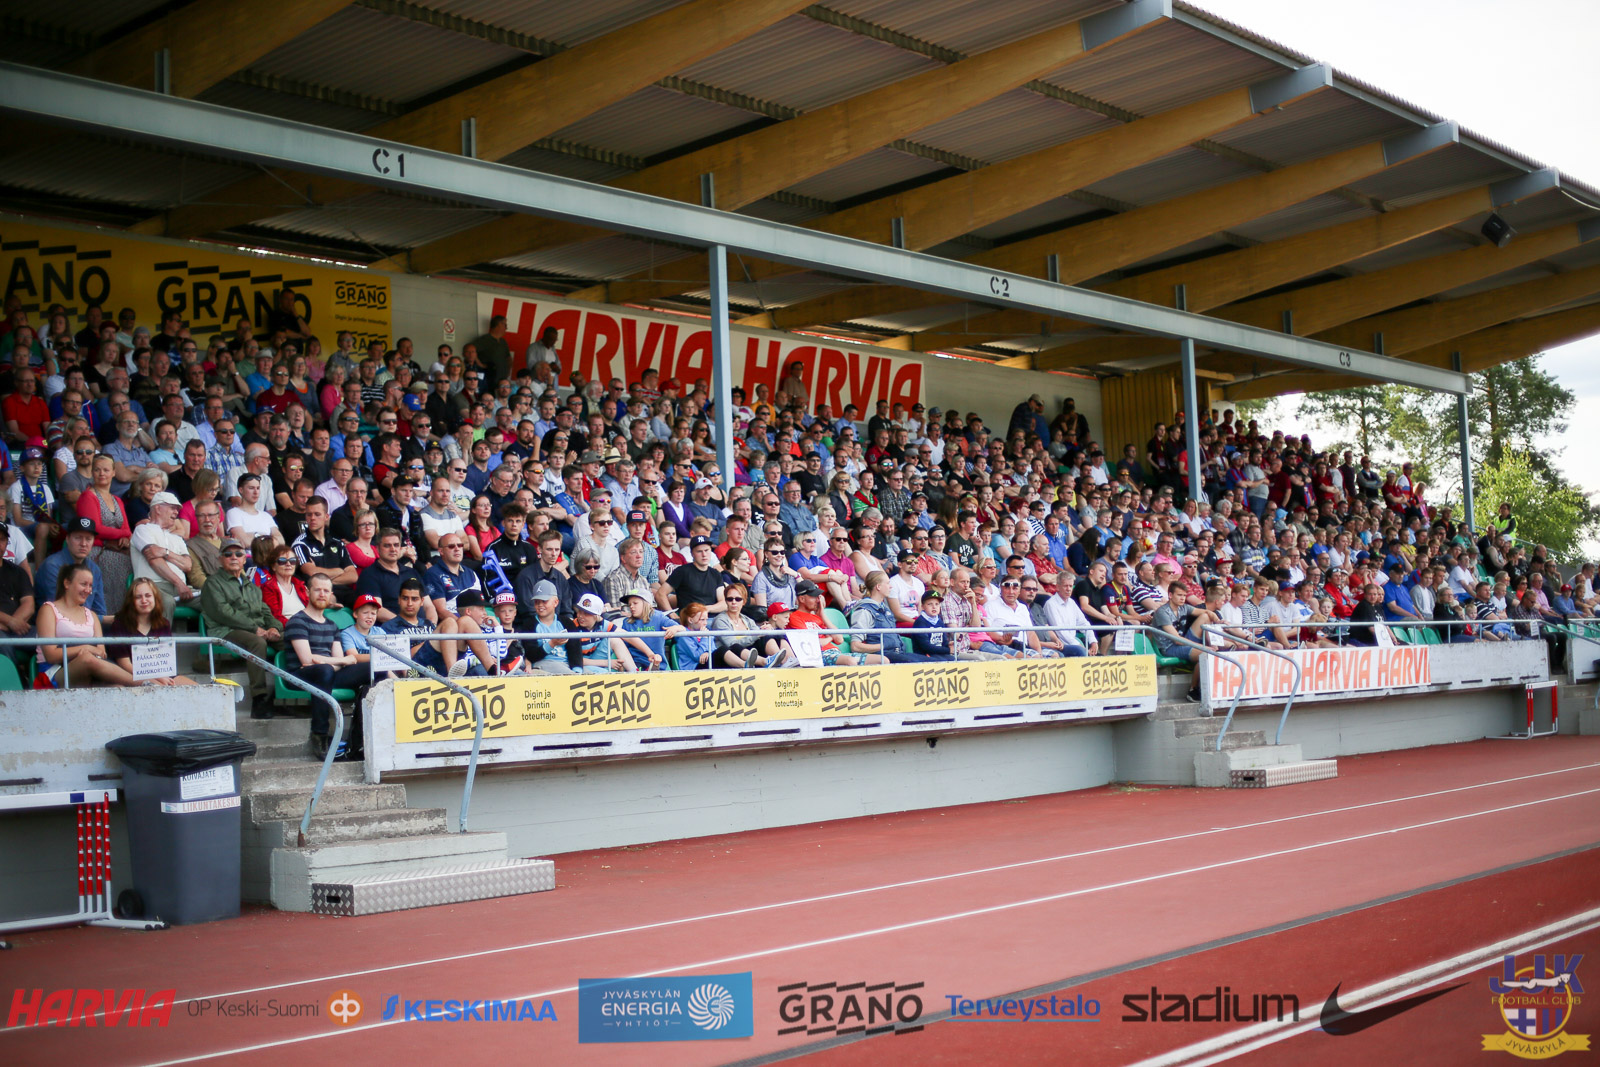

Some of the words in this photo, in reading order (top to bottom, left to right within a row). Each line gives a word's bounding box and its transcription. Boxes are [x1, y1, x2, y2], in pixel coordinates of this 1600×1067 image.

[371, 148, 405, 178] C1
[335, 285, 387, 305] GRANO
[990, 275, 1010, 298] C2
[488, 297, 714, 400] HARVIA
[741, 336, 923, 422] HARVIA
[1339, 351, 1351, 367] C3
[984, 671, 996, 679] Digin
[1018, 670, 1066, 692] GRANO
[1082, 667, 1128, 688] GRANO
[1212, 652, 1295, 698] HARVIA
[1301, 649, 1372, 692] HARVIA
[1378, 647, 1431, 687] HARVI
[524, 689, 543, 700] Digin
[544, 690, 552, 700] ja
[776, 680, 793, 690] Digin
[793, 680, 799, 689] ja
[778, 689, 798, 698] printin
[821, 679, 882, 703] GRANO
[913, 675, 970, 698] GRANO
[526, 701, 550, 711] printin
[571, 688, 651, 716] GRANO
[685, 684, 756, 711] GRANO
[774, 699, 804, 708] toteuttaja
[521, 711, 556, 722] toteuttaja
